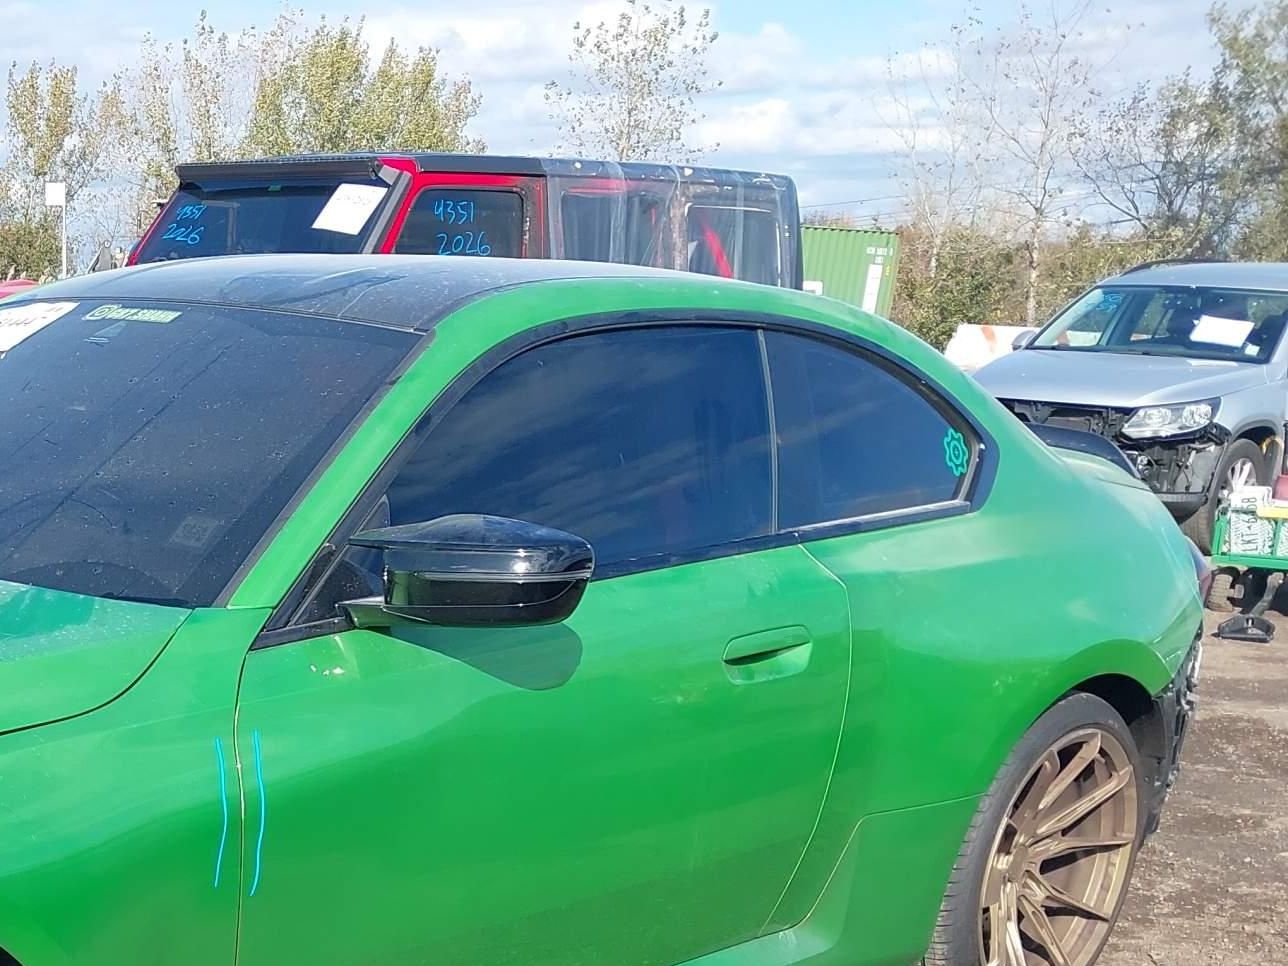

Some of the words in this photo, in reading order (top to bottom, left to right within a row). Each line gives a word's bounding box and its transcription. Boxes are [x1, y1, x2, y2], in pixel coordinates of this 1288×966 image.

[434, 199, 475, 225] 4351
[161, 223, 204, 244] 2026
[435, 231, 491, 256] 2026
